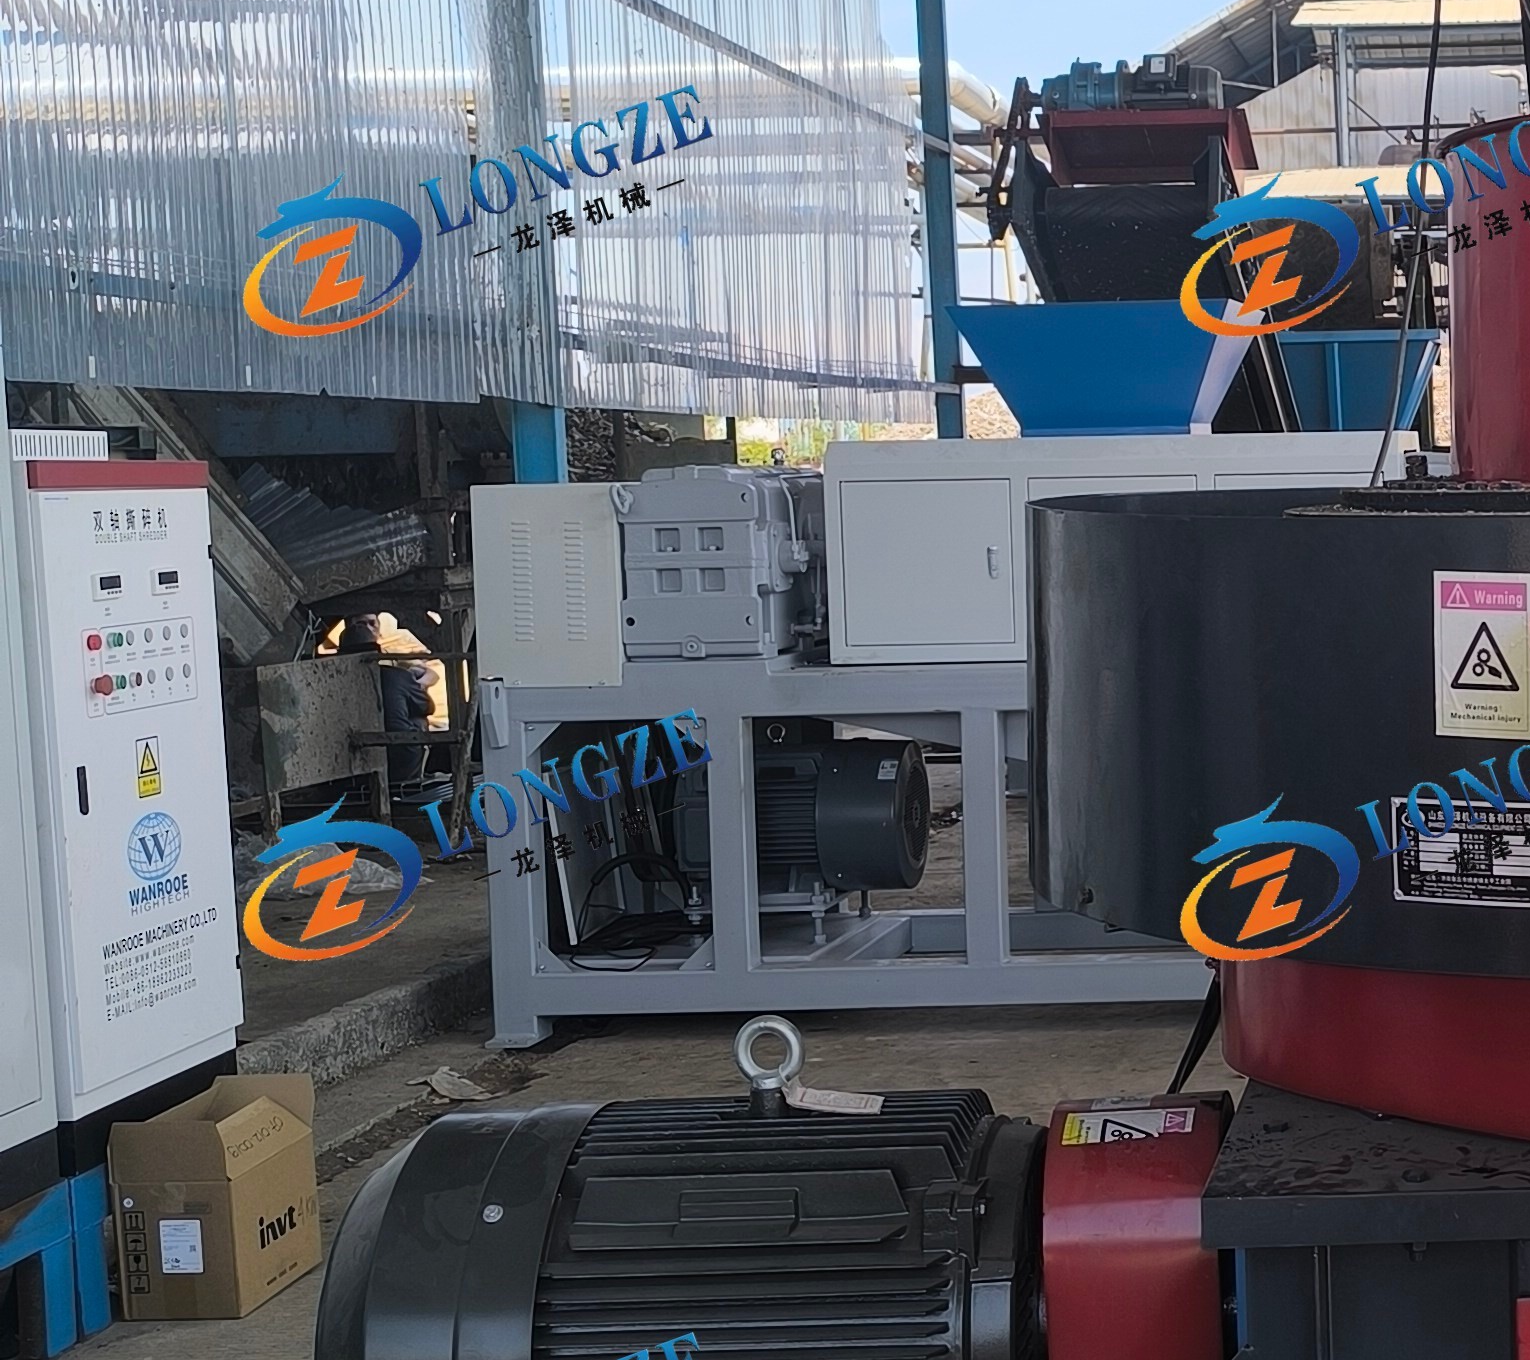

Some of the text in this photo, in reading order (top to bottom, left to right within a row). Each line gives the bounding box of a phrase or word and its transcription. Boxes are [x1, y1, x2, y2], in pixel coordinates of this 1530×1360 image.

[1474, 590, 1523, 608] Warning
[1450, 712, 1496, 721] Mechanical
[128, 874, 188, 906] WANROOE
[131, 890, 190, 916] HIGHTECH
[103, 932, 144, 960] WANROOE
[145, 917, 189, 945] MACHINERY
[259, 1205, 297, 1249] invt
